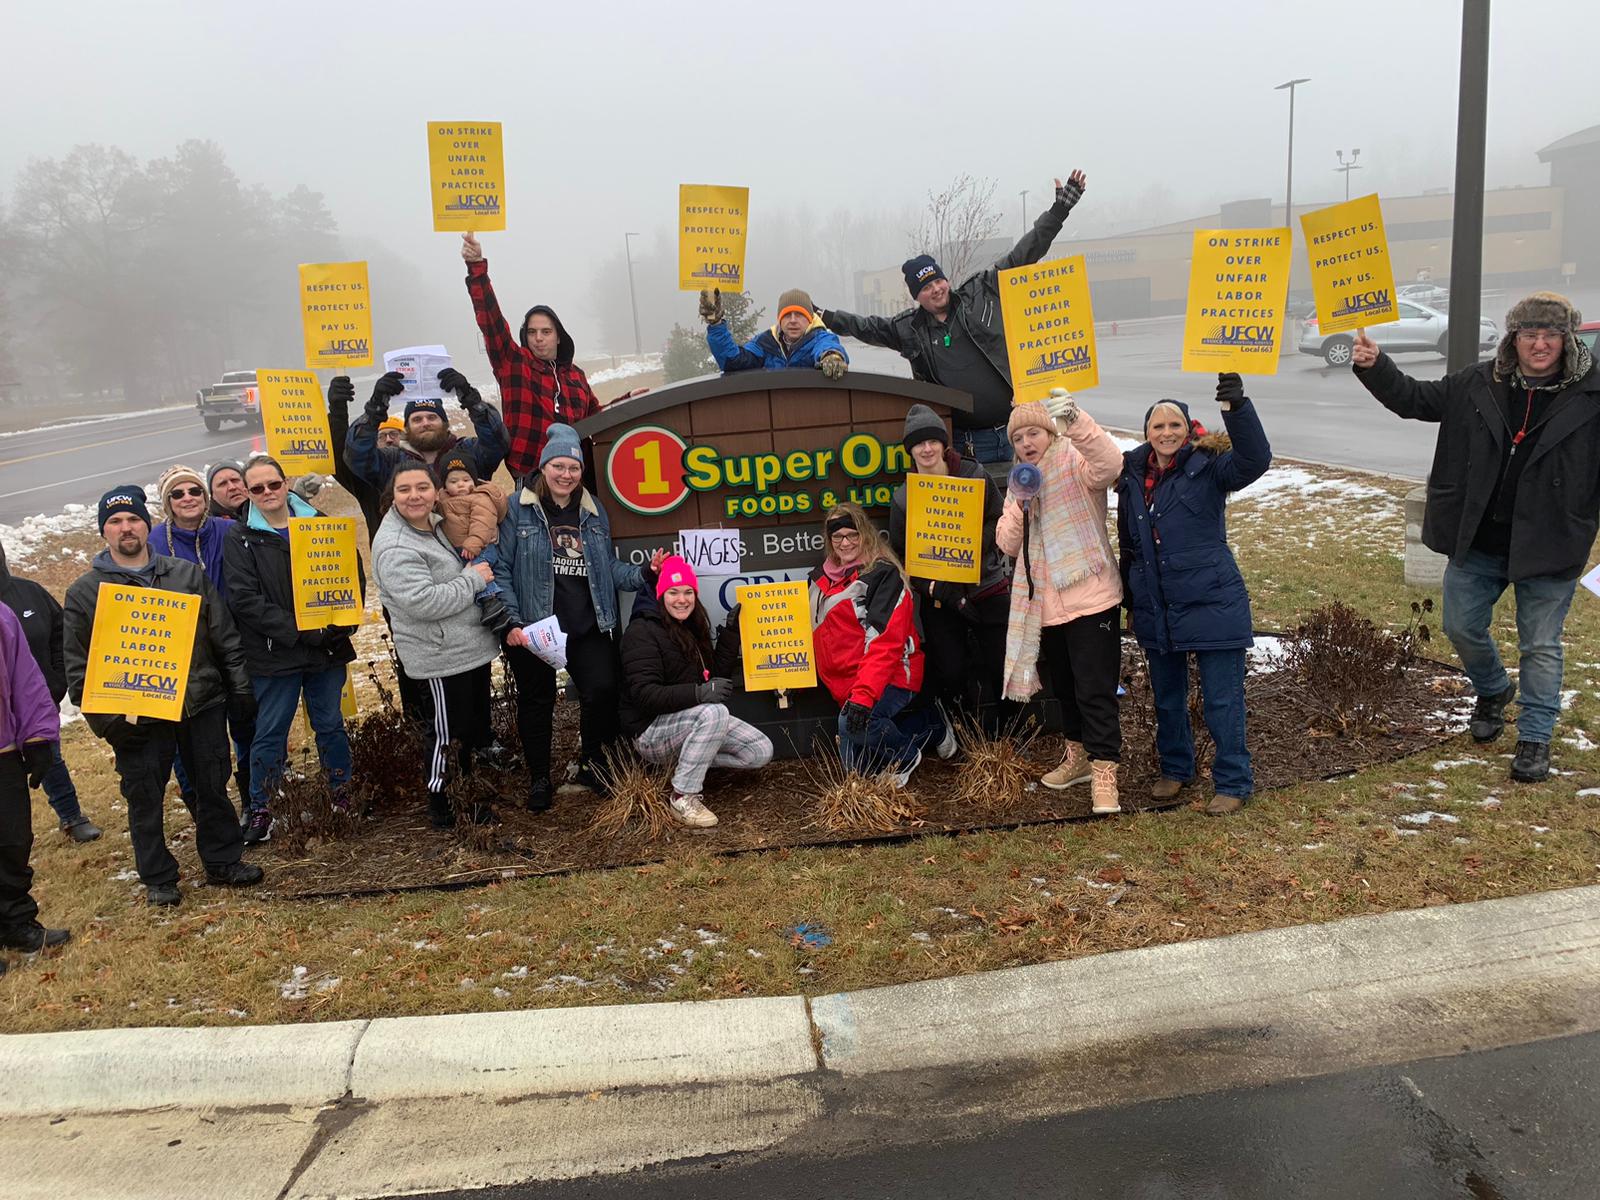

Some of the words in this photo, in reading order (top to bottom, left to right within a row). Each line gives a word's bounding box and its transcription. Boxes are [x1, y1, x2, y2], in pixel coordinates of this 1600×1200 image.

[459, 195, 498, 206] UFCW
[1314, 227, 1356, 245] RESPECT
[1361, 222, 1378, 232] US.
[1209, 238, 1228, 246] ON
[1235, 237, 1280, 247] STRIKE
[1226, 256, 1261, 264] OVER
[1316, 251, 1361, 268] PROTECT
[1366, 246, 1383, 256] US.
[705, 263, 740, 274] UFCW
[1010, 275, 1027, 285] ON
[1034, 265, 1075, 280] STRIKE
[1216, 274, 1267, 282] UNFAIR
[1332, 277, 1352, 288] PAY
[1357, 273, 1374, 282] US.
[1029, 285, 1060, 298] OVER
[1217, 291, 1262, 300] LABOR
[1345, 289, 1388, 308] UFCW
[1024, 300, 1070, 316] UNFAIR
[1201, 308, 1273, 318] PRACTICES
[1030, 317, 1069, 332] LABOR
[1222, 326, 1274, 341] UFCW
[331, 339, 367, 351] UFCW
[1020, 330, 1084, 350] PRACTICES
[1041, 345, 1088, 366] UFCW
[1062, 366, 1079, 374] Local
[292, 440, 326, 451] UFCW
[634, 440, 670, 494] 1
[686, 446, 833, 491] Super
[939, 482, 974, 493] STRIKE
[106, 495, 133, 504] UFCW
[726, 492, 811, 516] FOODS
[822, 492, 837, 508] &
[850, 487, 896, 505] LIQ
[933, 496, 959, 504] OVER
[926, 507, 965, 518] UNFAIR
[928, 521, 961, 530] LABOR
[762, 531, 824, 555] Bette
[917, 532, 972, 544] PRACTICES
[681, 534, 740, 566] WAGES
[932, 546, 973, 560] UFCW
[552, 557, 586, 567] AQUILL
[553, 564, 588, 577] TMEAL
[303, 577, 350, 586] PRACTICES
[317, 590, 352, 602] UFCW
[766, 588, 799, 596] STRIKE
[115, 593, 134, 602] ON
[141, 596, 187, 610] STRIKE
[131, 611, 166, 622] OVER
[757, 615, 794, 623] UNFAIR
[121, 625, 172, 638] UNFAIR
[761, 628, 792, 636] LABOR
[121, 641, 166, 653] LABOR
[752, 640, 804, 649] PRACTICES
[104, 655, 177, 670] PRACTICES
[768, 652, 807, 666] UFCW
[124, 672, 177, 690] UFCW
